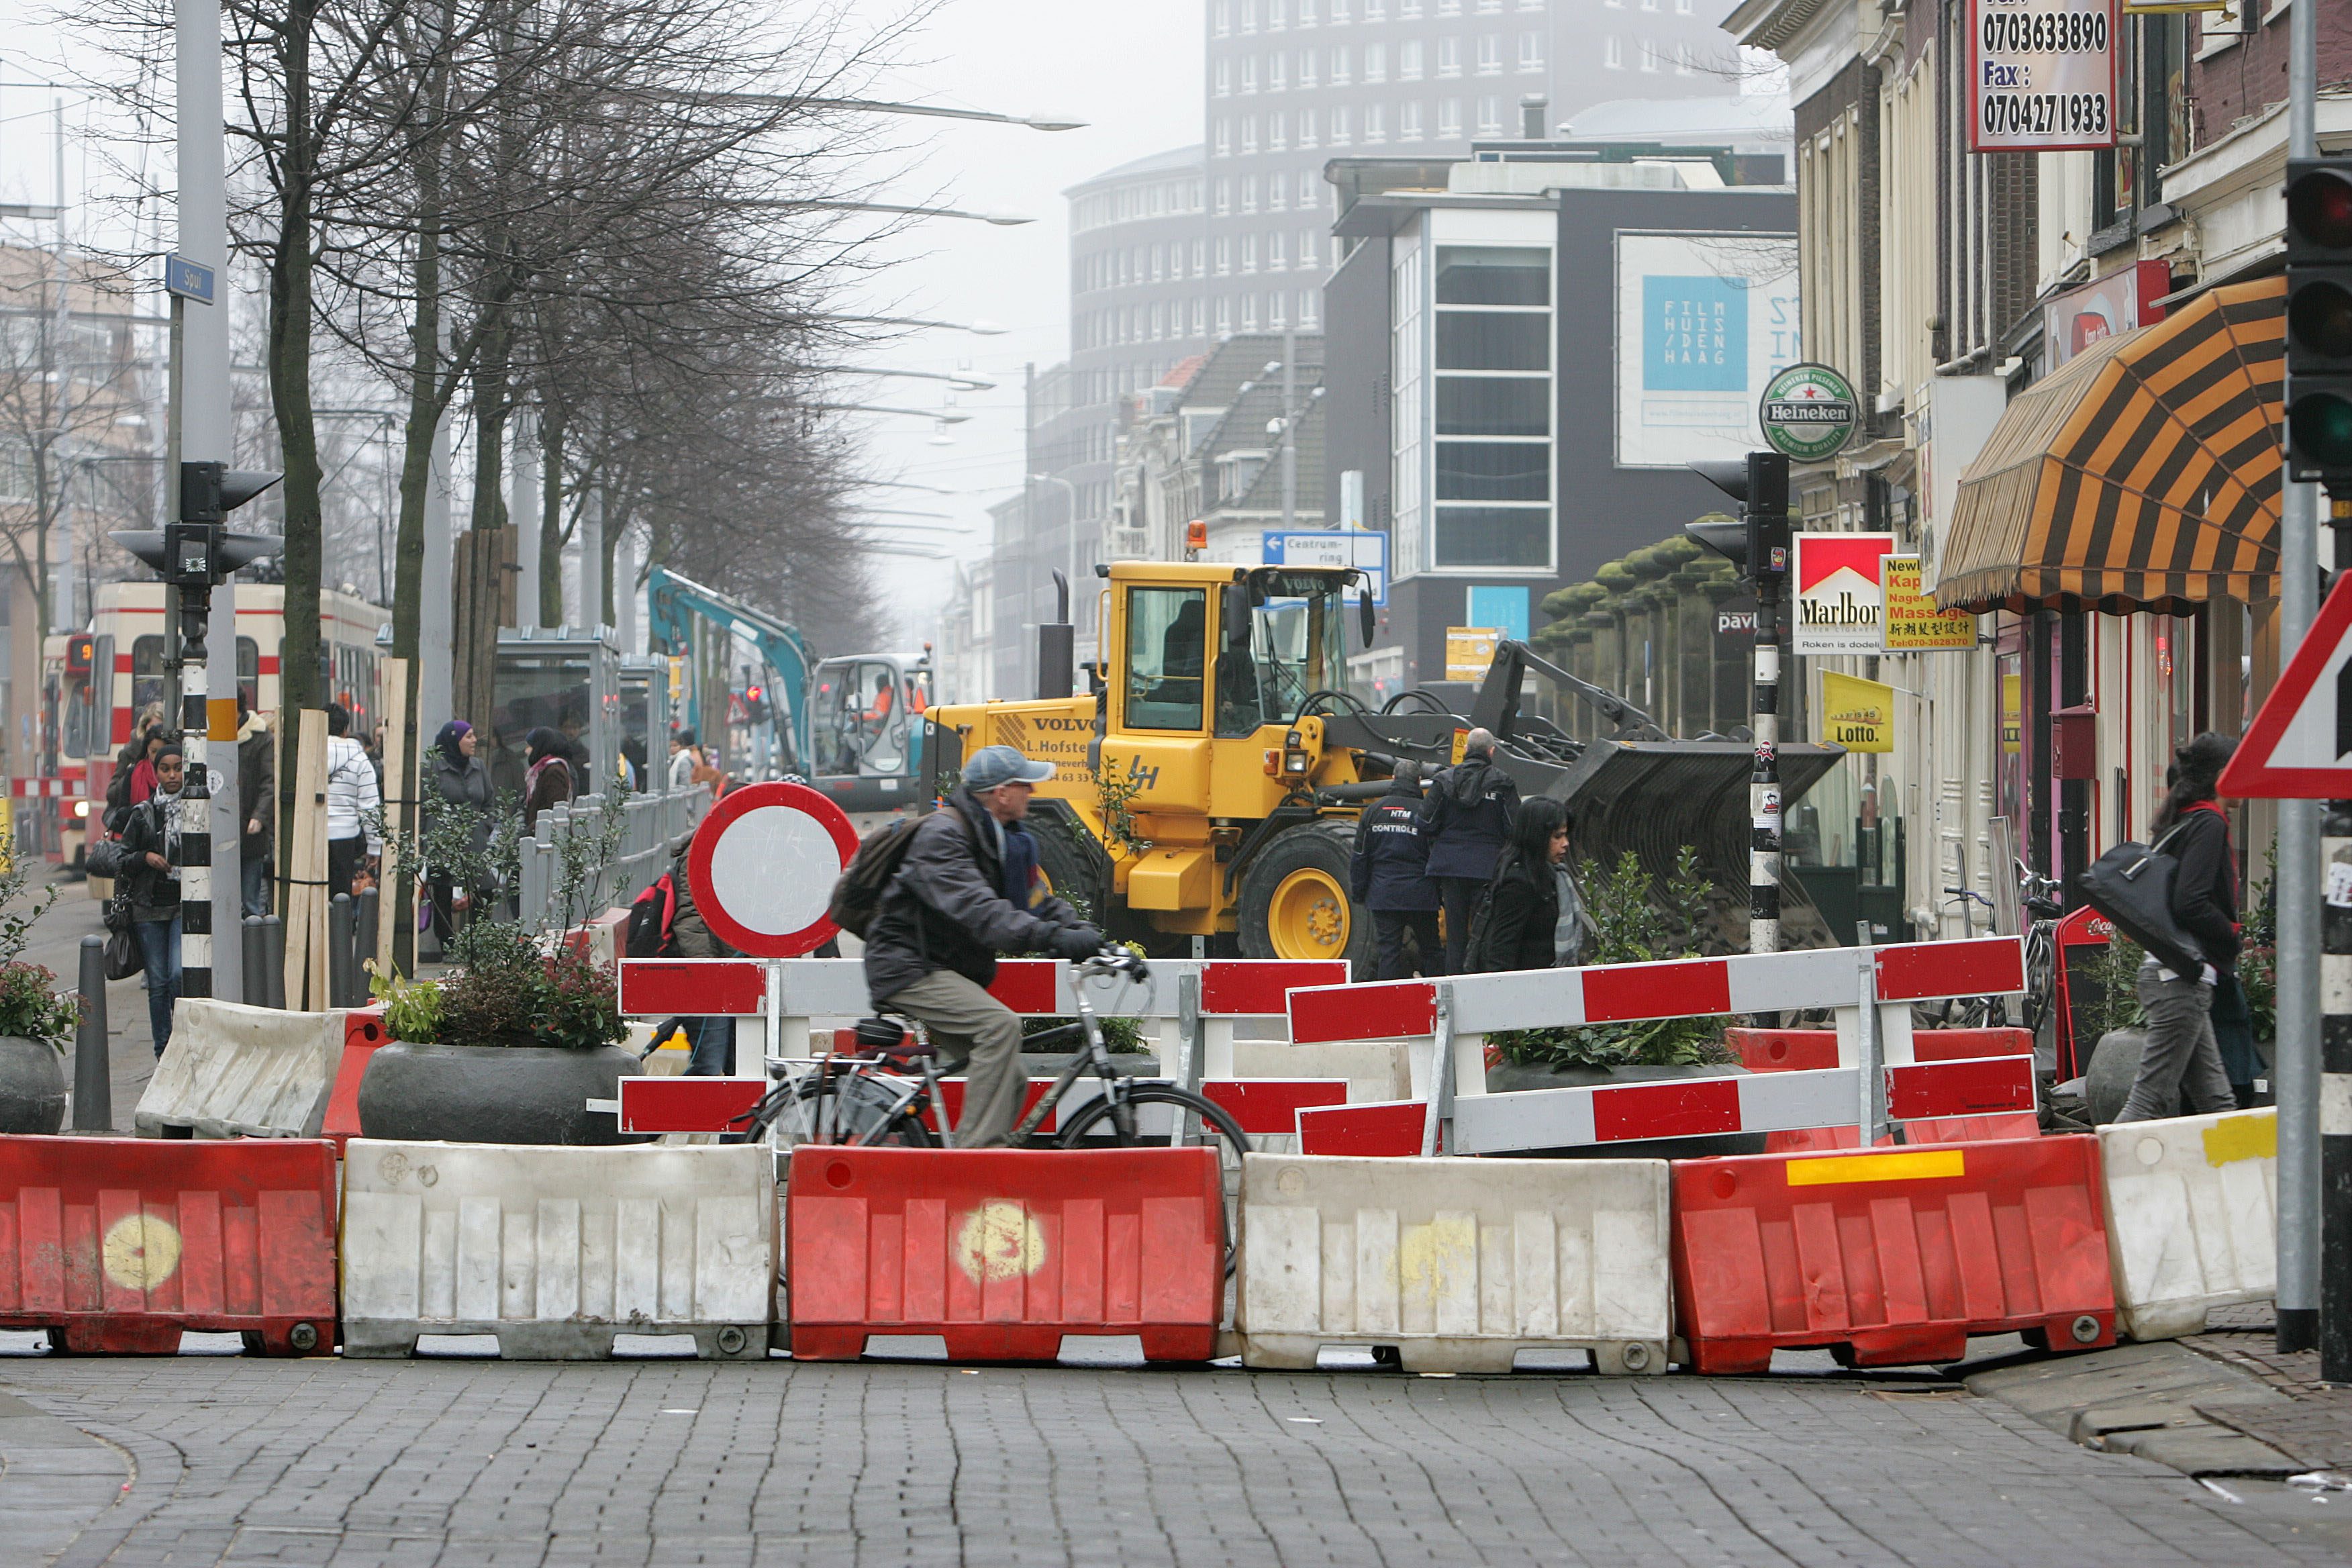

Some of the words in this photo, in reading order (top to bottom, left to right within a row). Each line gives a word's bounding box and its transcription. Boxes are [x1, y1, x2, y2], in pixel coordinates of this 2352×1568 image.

[1983, 12, 2106, 52] 0703633890
[1983, 60, 2018, 86] Fax
[1984, 93, 2107, 133] 0704271933
[184, 268, 201, 291] Spui
[1665, 301, 1725, 315] FILM
[1771, 297, 1800, 324] S
[1665, 317, 1725, 332] HUIS
[1665, 350, 1725, 365] HAAG
[1777, 373, 1810, 394] HEINEKEN
[1812, 373, 1841, 394] PILSENER
[1771, 405, 1847, 420] Heineken
[1775, 430, 1810, 452] PREMIUM
[1812, 430, 1841, 452] QUALITY
[1287, 538, 1342, 549] Centrum-
[1319, 552, 1342, 565] ring
[1283, 576, 1325, 591] VOLVO
[1889, 575, 1920, 590] Kap
[1799, 592, 1879, 625] Marlbor
[1718, 611, 1757, 632] pavl
[82, 644, 93, 660] 9
[1027, 740, 1086, 752] L.Hofste
[1390, 810, 1412, 818] HTM
[1372, 825, 1418, 835] CONTROLE
